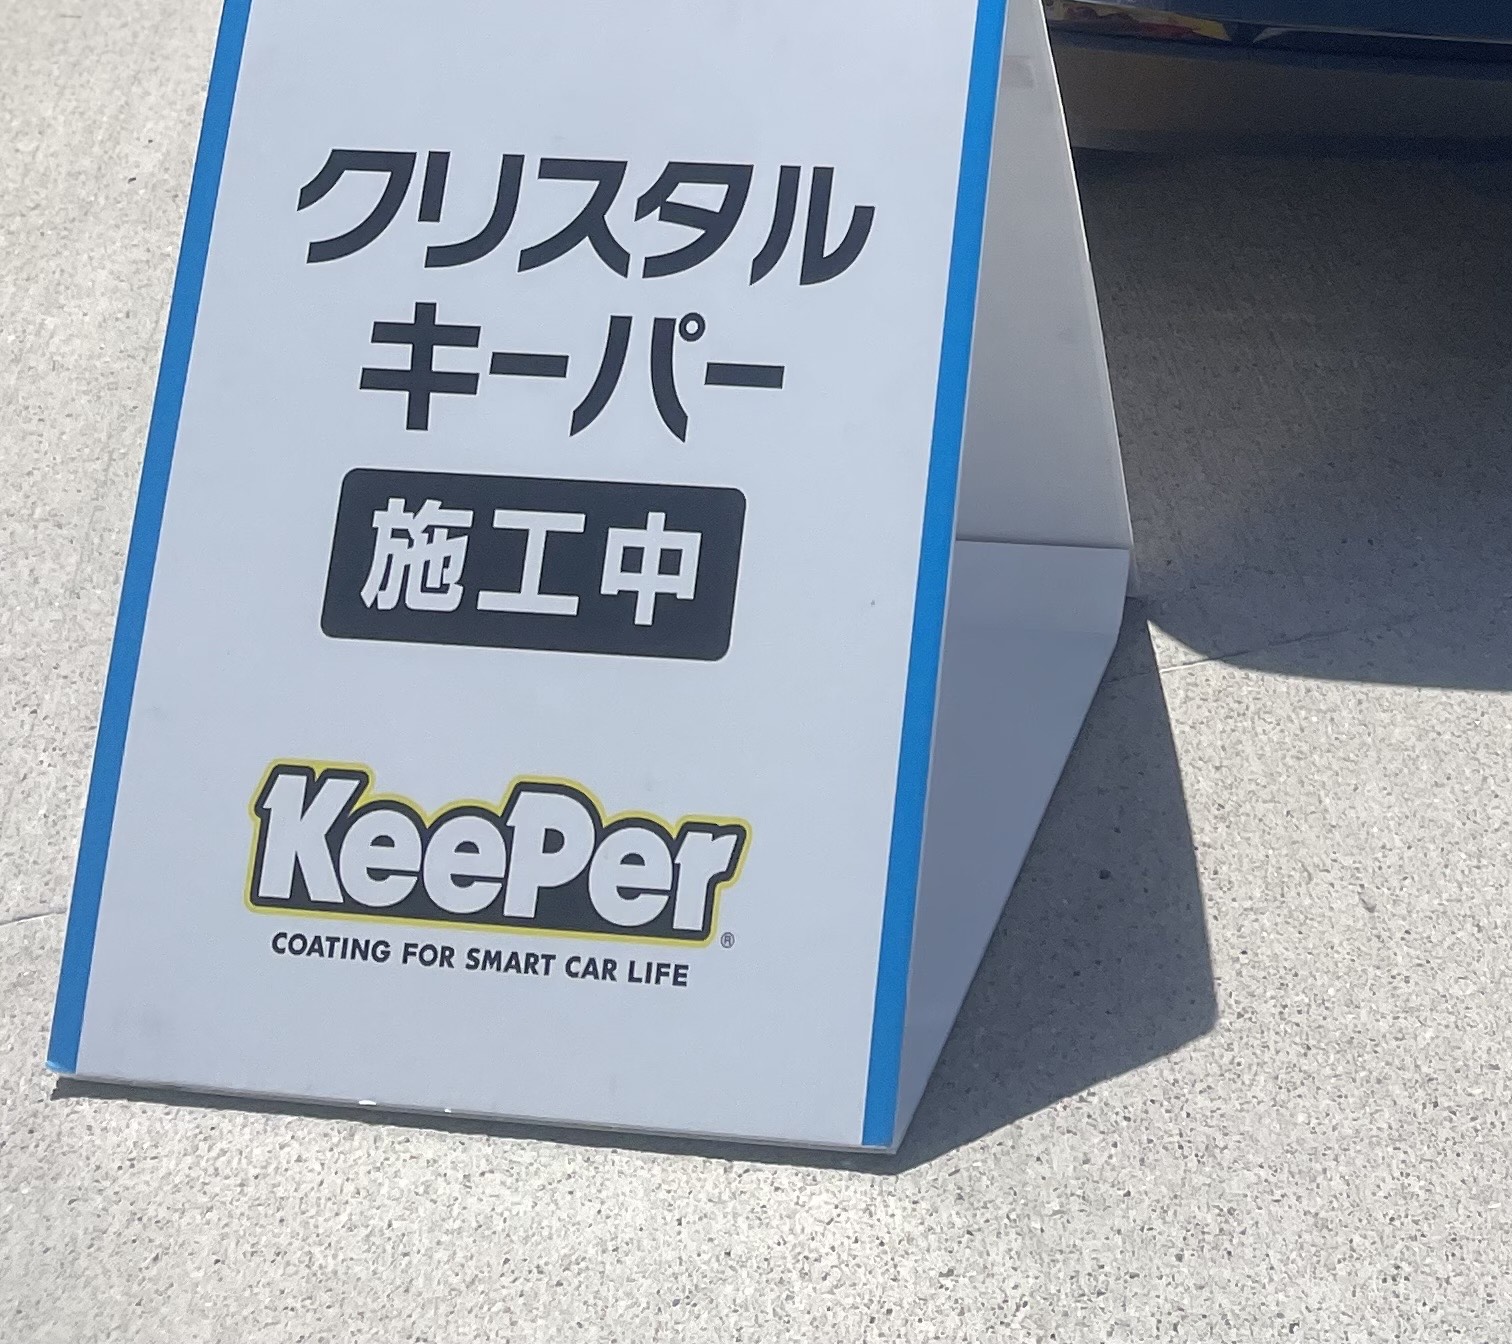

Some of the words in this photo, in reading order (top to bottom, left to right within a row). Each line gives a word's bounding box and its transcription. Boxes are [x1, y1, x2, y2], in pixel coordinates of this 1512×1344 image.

[297, 148, 875, 285] クリスタル
[359, 301, 785, 443] キーパー
[360, 497, 702, 625] 施工中
[250, 764, 747, 941] KeePer
[271, 931, 392, 964] COATING
[401, 943, 455, 969] FOR
[464, 947, 556, 978] SMART
[565, 955, 617, 983] CAR
[627, 960, 690, 987] LIFE
